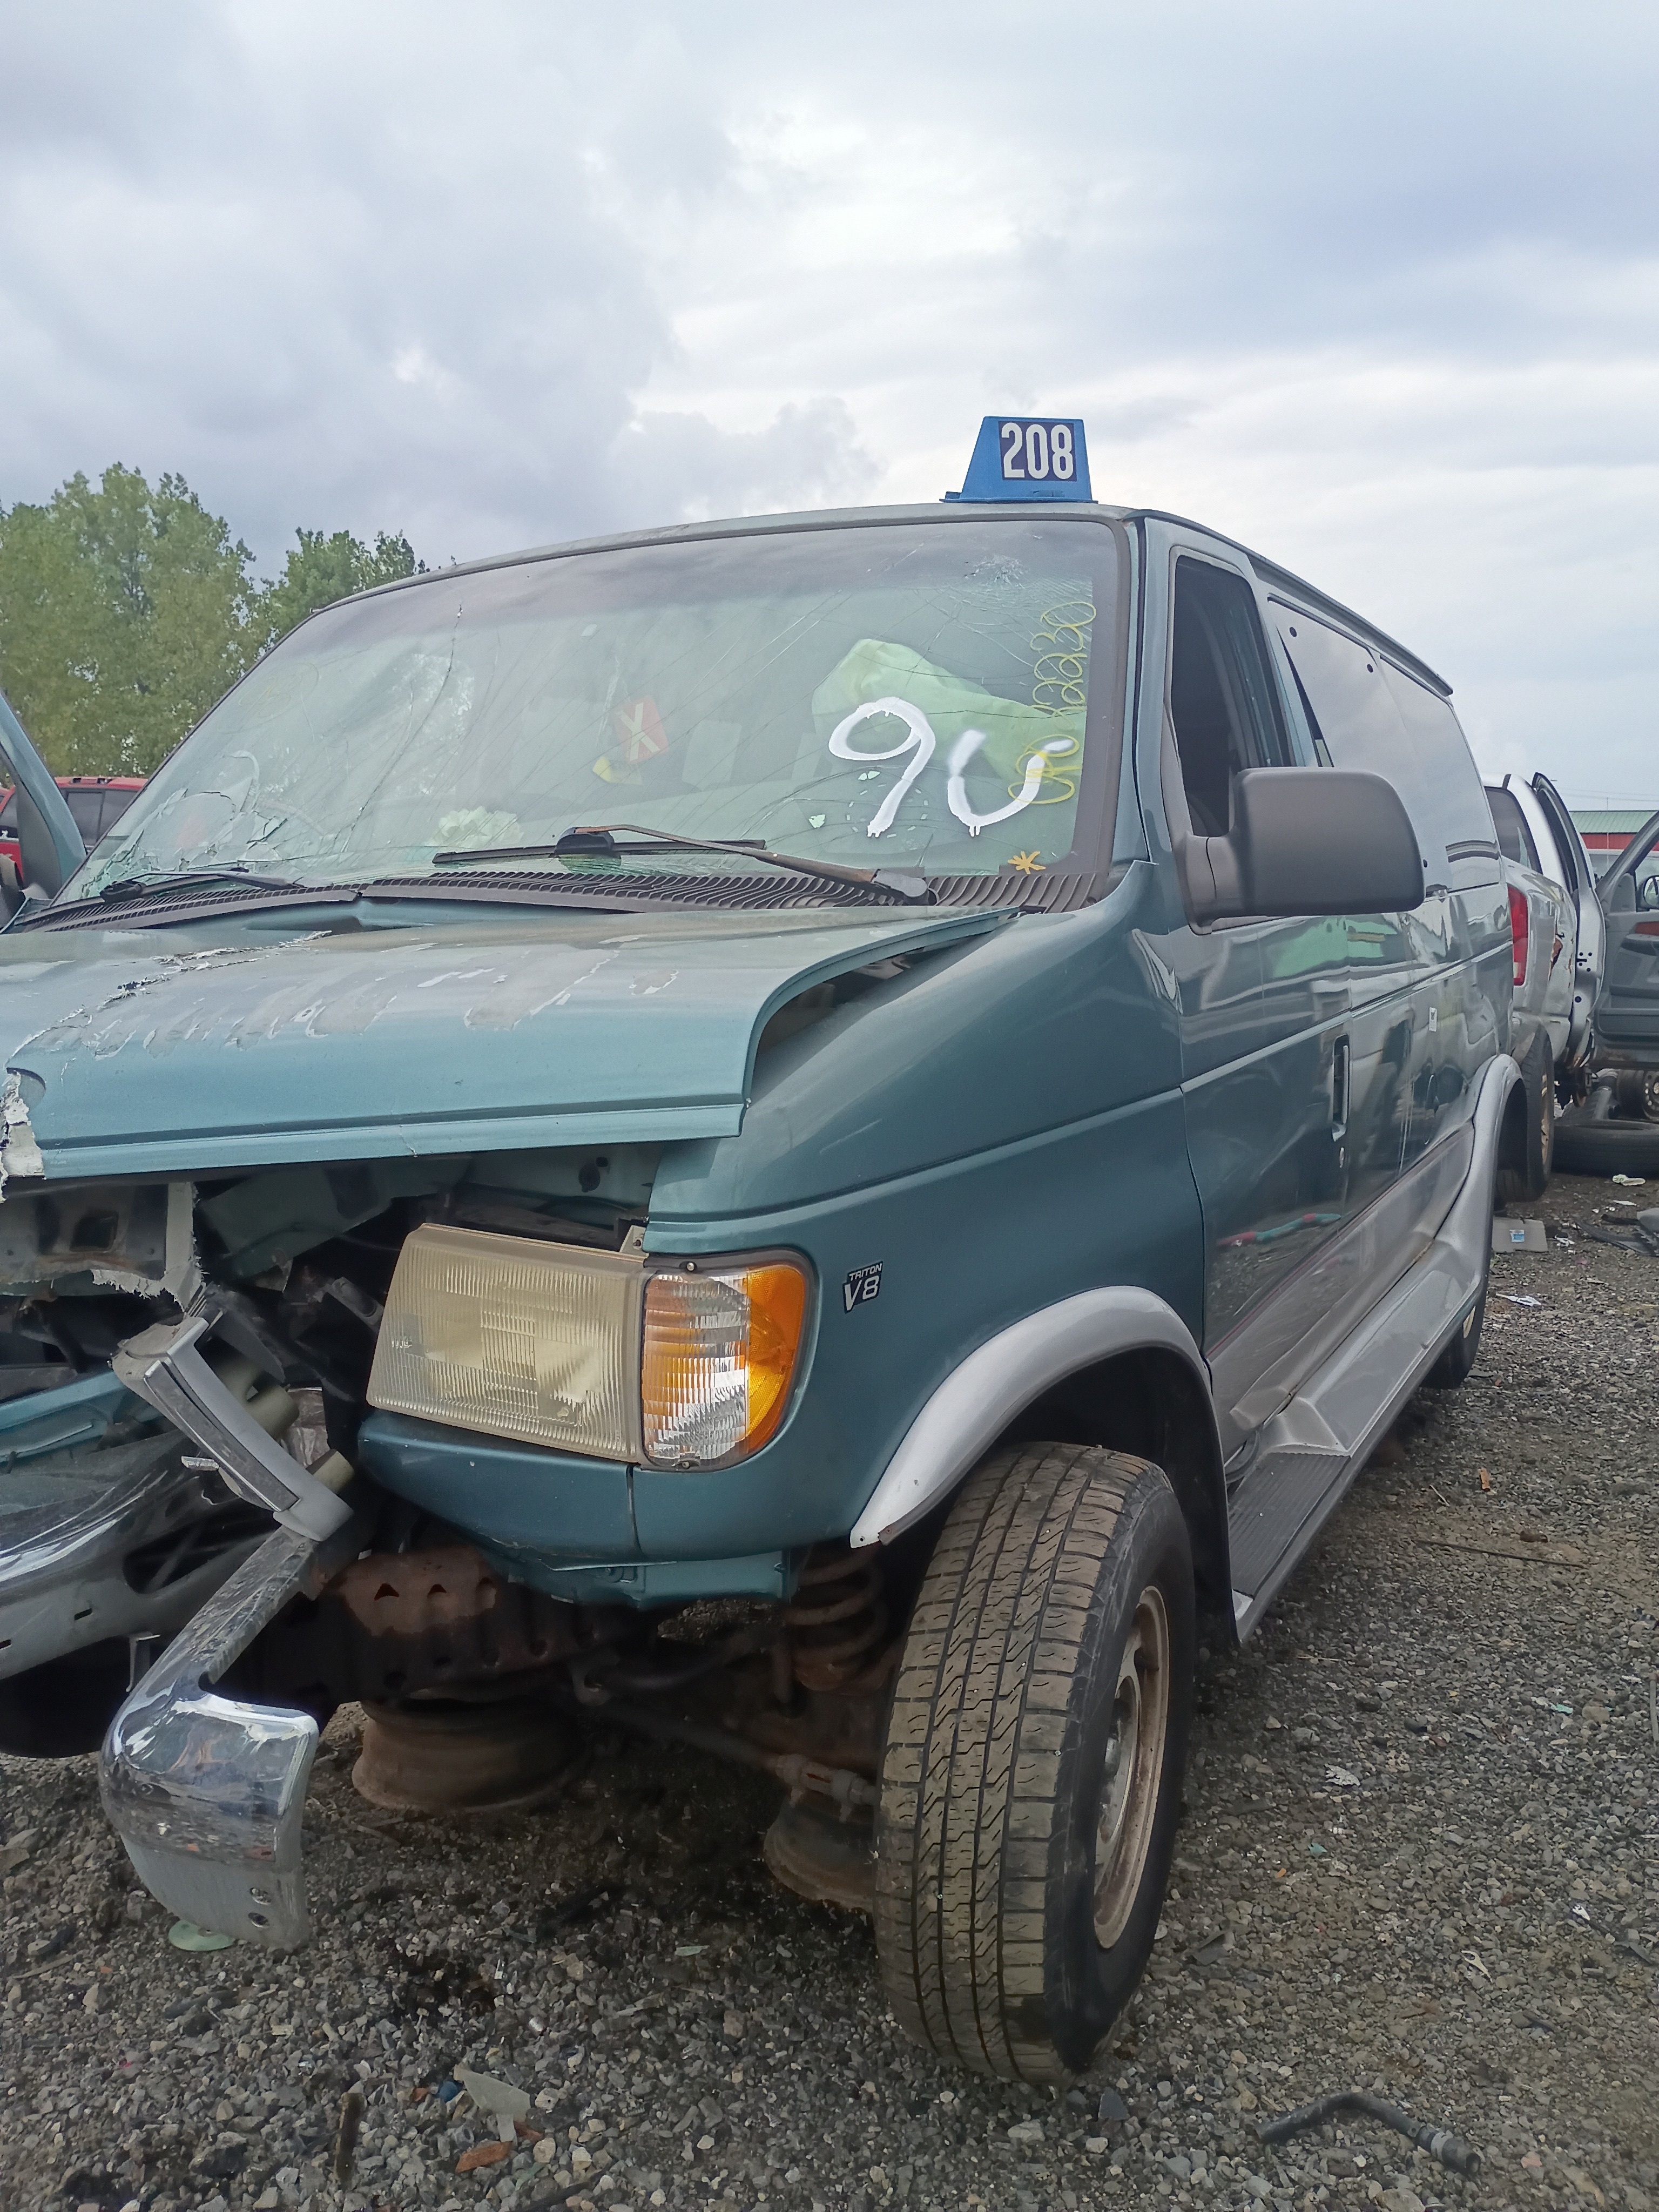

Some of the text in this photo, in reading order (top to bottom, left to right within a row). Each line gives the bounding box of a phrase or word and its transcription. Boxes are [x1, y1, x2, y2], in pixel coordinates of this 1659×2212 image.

[1001, 422, 1074, 480] 208
[849, 1263, 883, 1282] TRITON
[844, 1275, 880, 1311] V8
